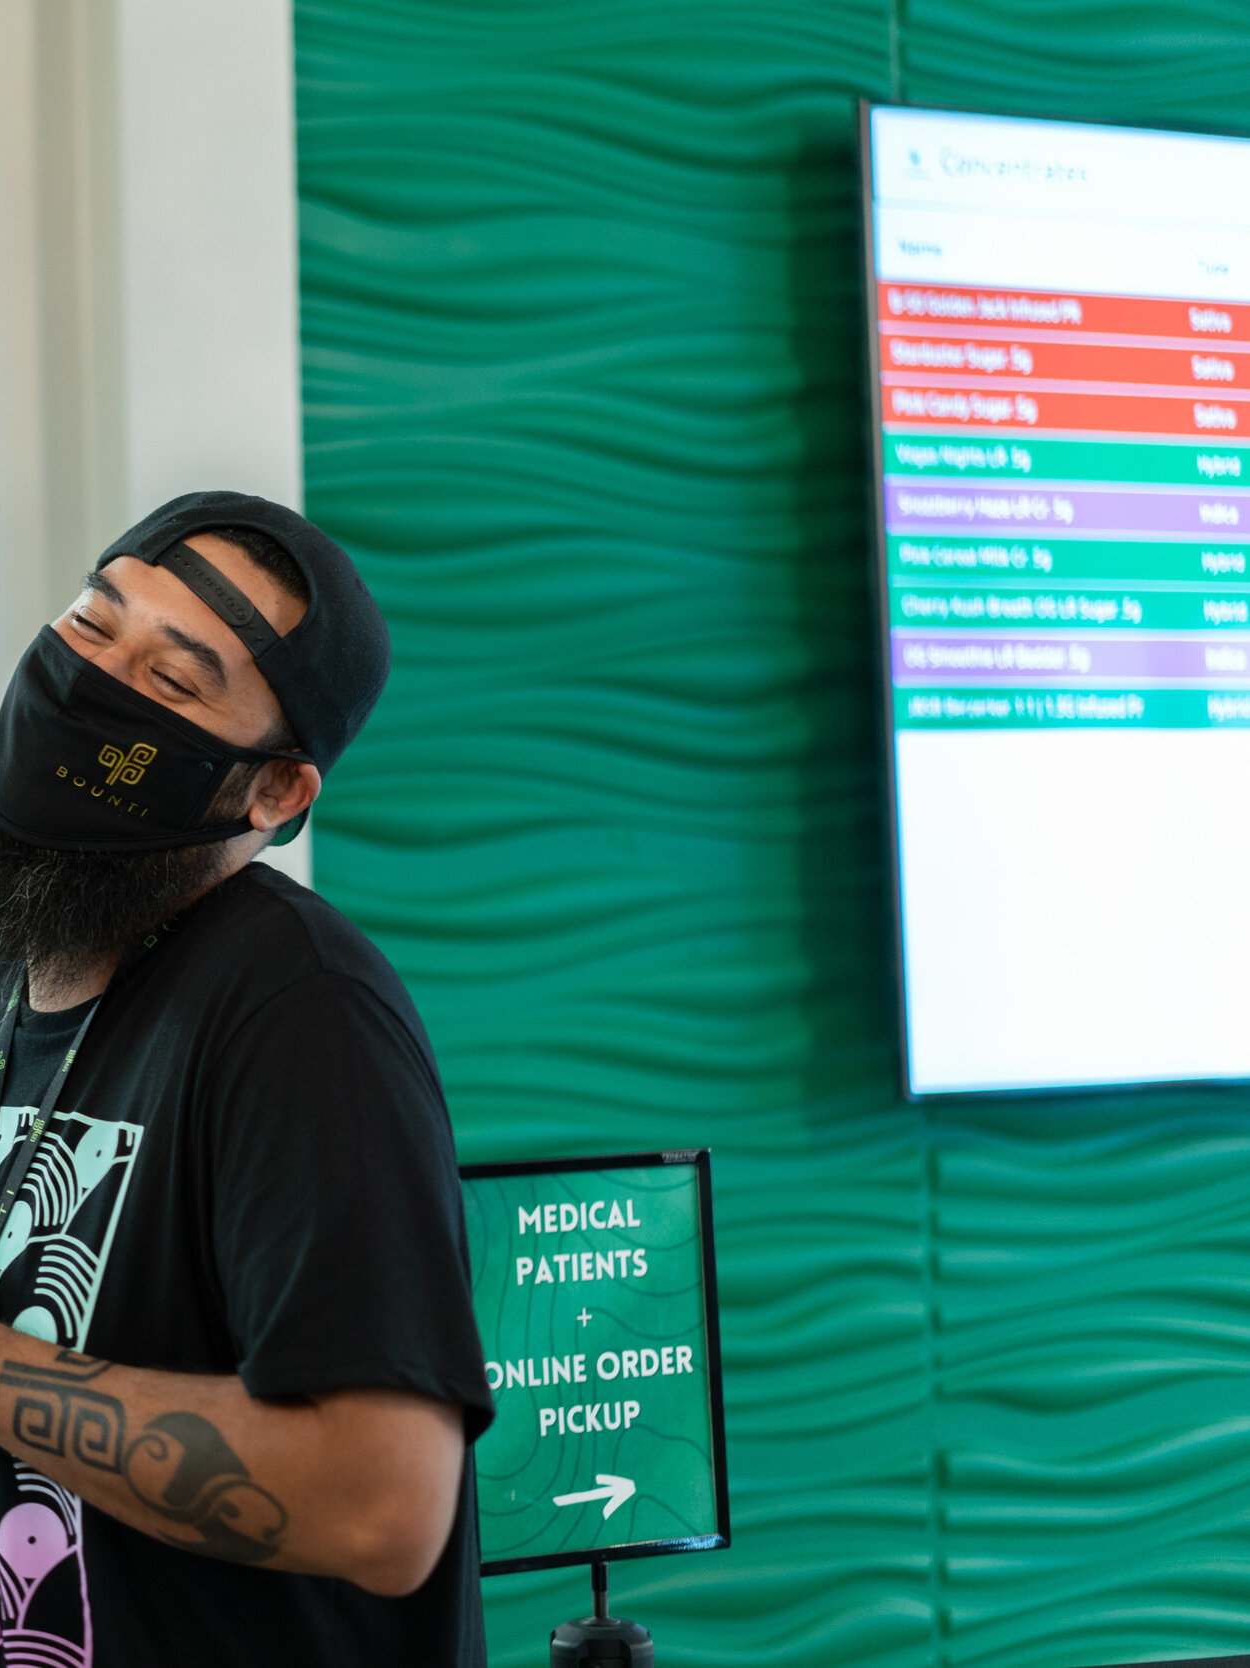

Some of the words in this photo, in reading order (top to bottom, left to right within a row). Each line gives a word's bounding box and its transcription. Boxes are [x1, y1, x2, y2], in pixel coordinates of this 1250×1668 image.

[56, 766, 148, 817] BOUNTI
[518, 1199, 641, 1235] MEDICAL
[516, 1248, 648, 1286] PATIENTS
[485, 1354, 587, 1390] ONLINE
[596, 1345, 693, 1380] ORDER
[539, 1400, 640, 1437] PICKUP
